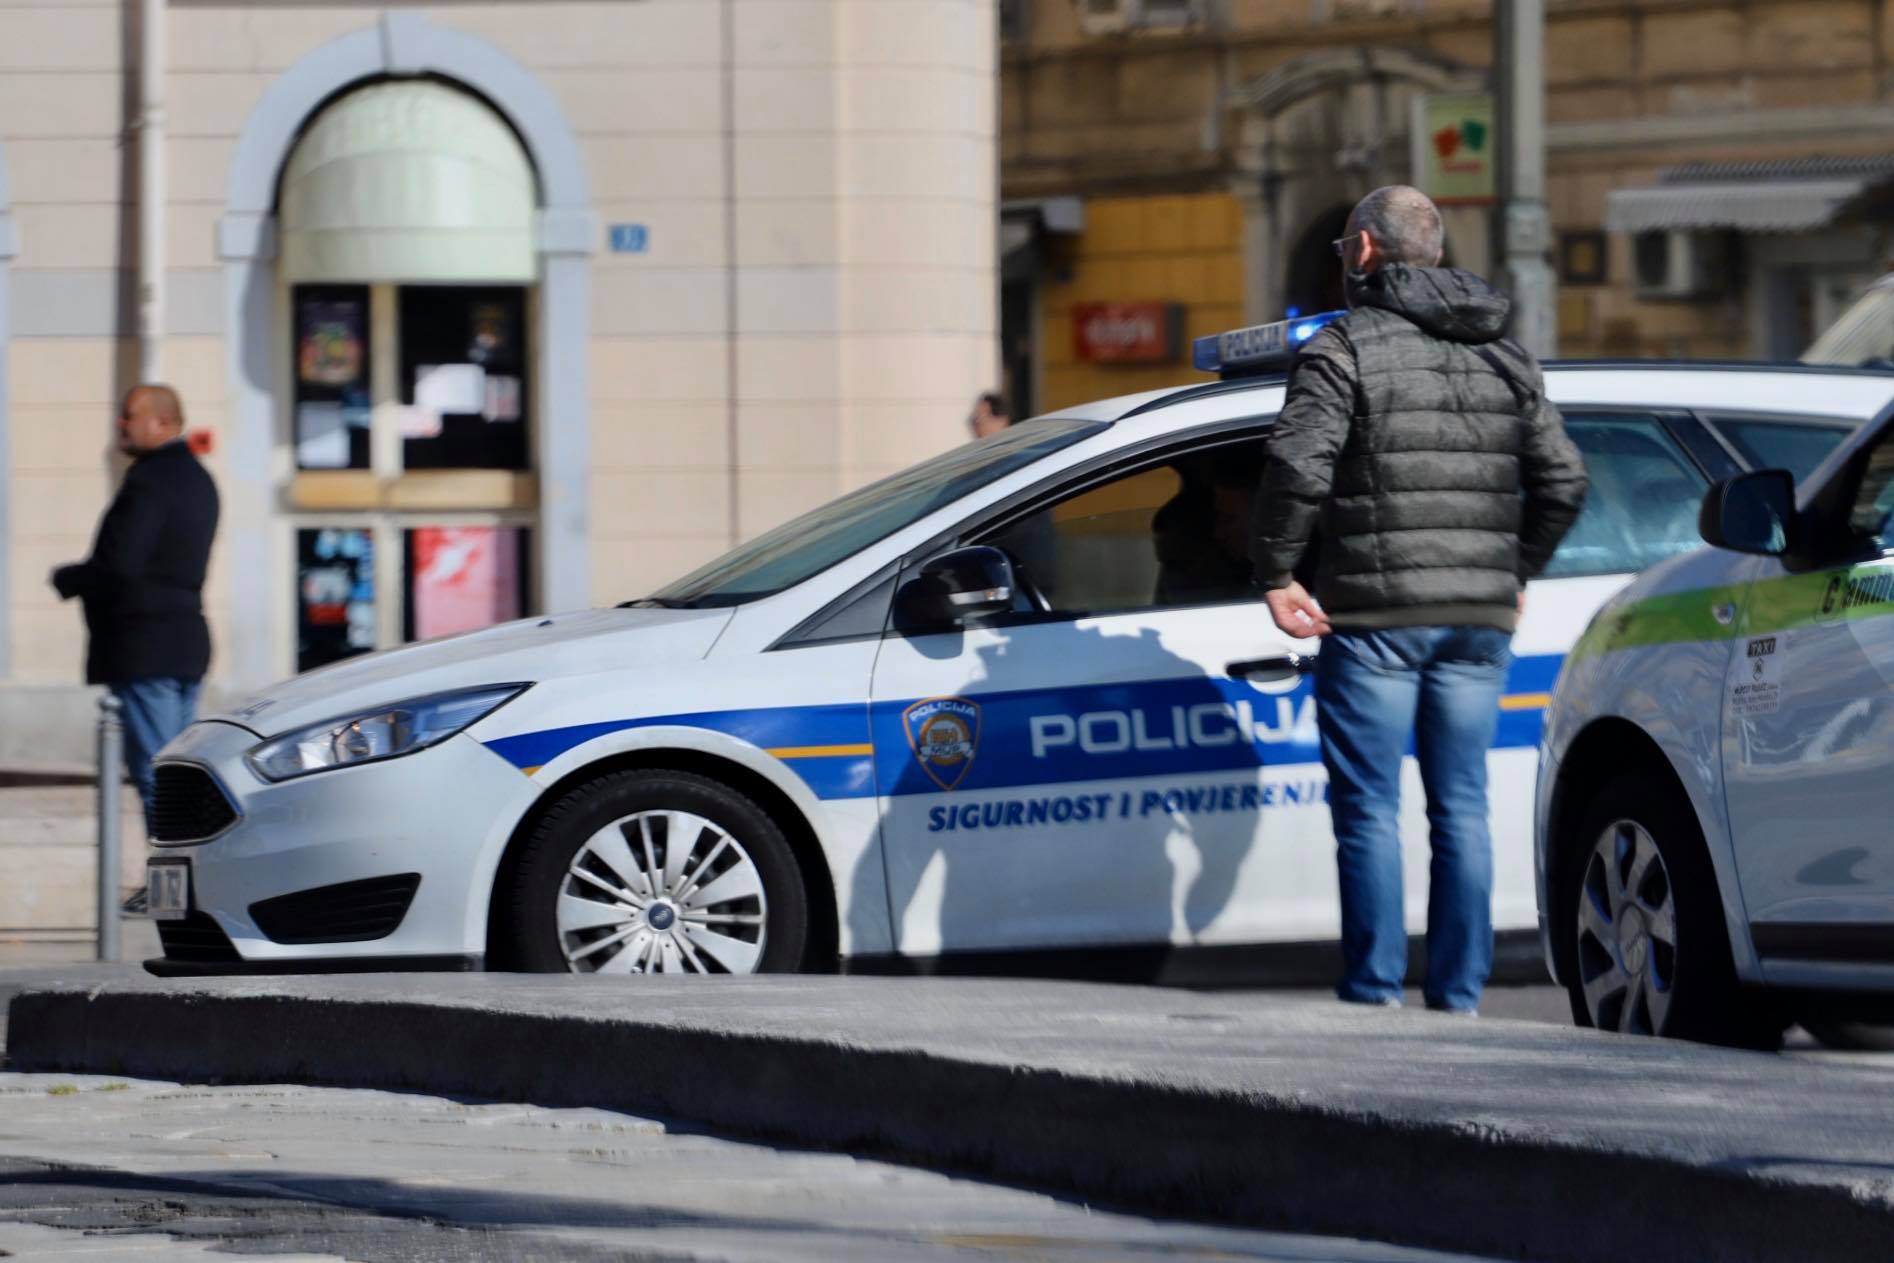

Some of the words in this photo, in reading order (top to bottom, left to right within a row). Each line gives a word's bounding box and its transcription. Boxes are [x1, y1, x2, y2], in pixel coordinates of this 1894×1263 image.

[1750, 638, 1775, 657] TAXI
[927, 793, 1112, 832] SIGURNOST
[1119, 791, 1131, 819] I
